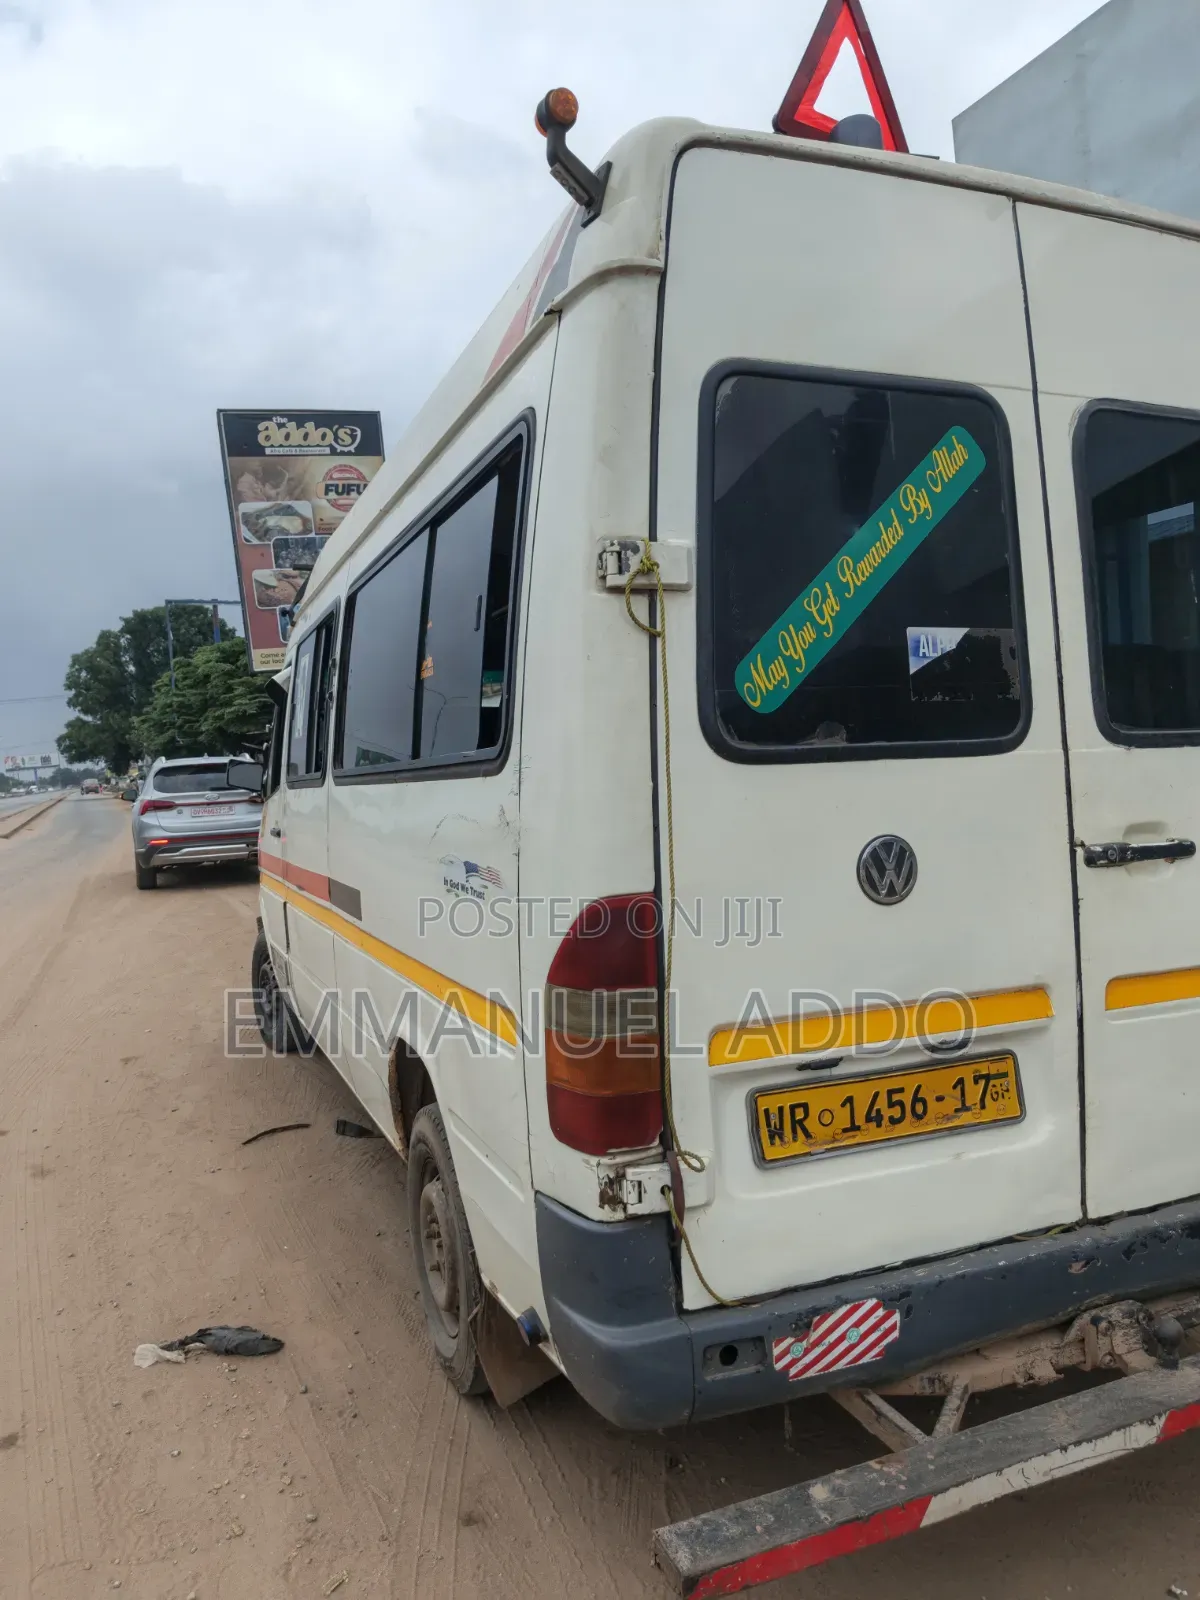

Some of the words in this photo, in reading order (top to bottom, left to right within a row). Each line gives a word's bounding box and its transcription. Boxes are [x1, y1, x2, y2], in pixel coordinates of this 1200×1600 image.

[272, 416, 288, 424] the
[743, 653, 789, 708] May
[778, 624, 817, 674] You
[803, 582, 840, 638] Get
[837, 507, 904, 598] Rewarded
[900, 483, 933, 524] By
[926, 435, 969, 493] Allah
[443, 876, 449, 887] In
[449, 879, 460, 891] God
[460, 882, 469, 894] We
[470, 886, 486, 900] Trust
[762, 1101, 814, 1146] WR
